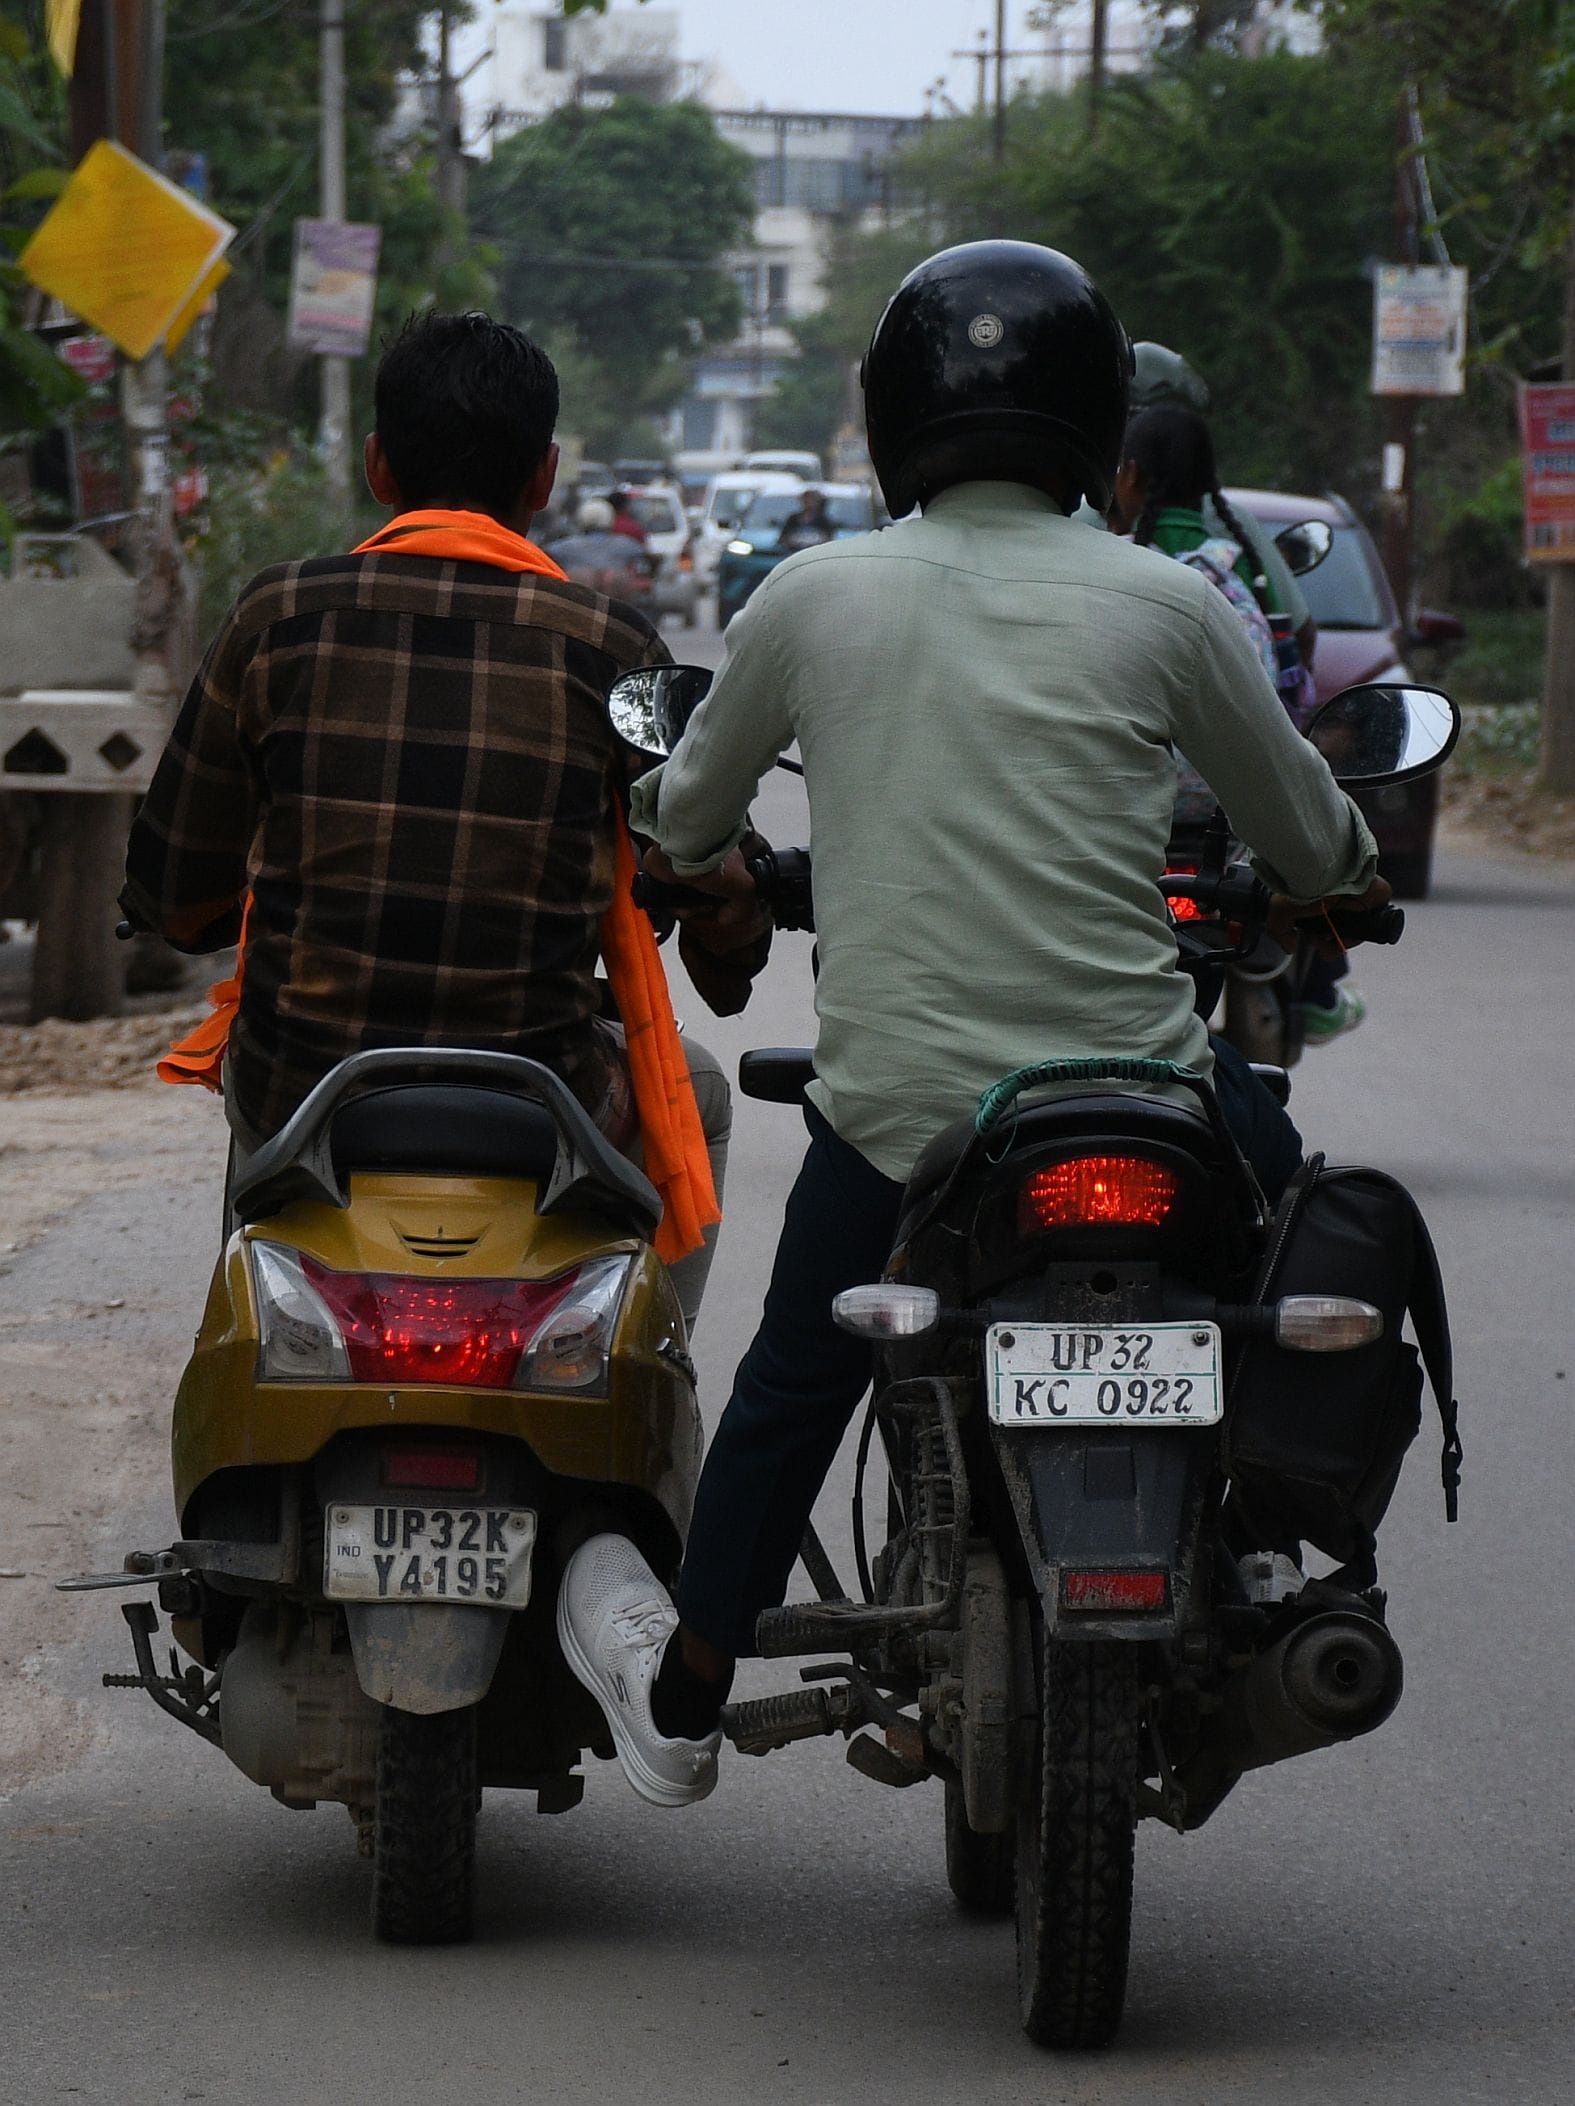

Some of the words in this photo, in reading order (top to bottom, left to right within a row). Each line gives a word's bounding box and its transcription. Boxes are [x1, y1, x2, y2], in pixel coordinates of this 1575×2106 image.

[1052, 1333, 1103, 1370] UP
[1111, 1334, 1153, 1370] 32
[1014, 1379, 1070, 1416] KC
[1097, 1379, 1193, 1416] 0922
[374, 1508, 510, 1553] UP32K
[336, 1545, 361, 1557] IND
[373, 1554, 508, 1600] Y4195
